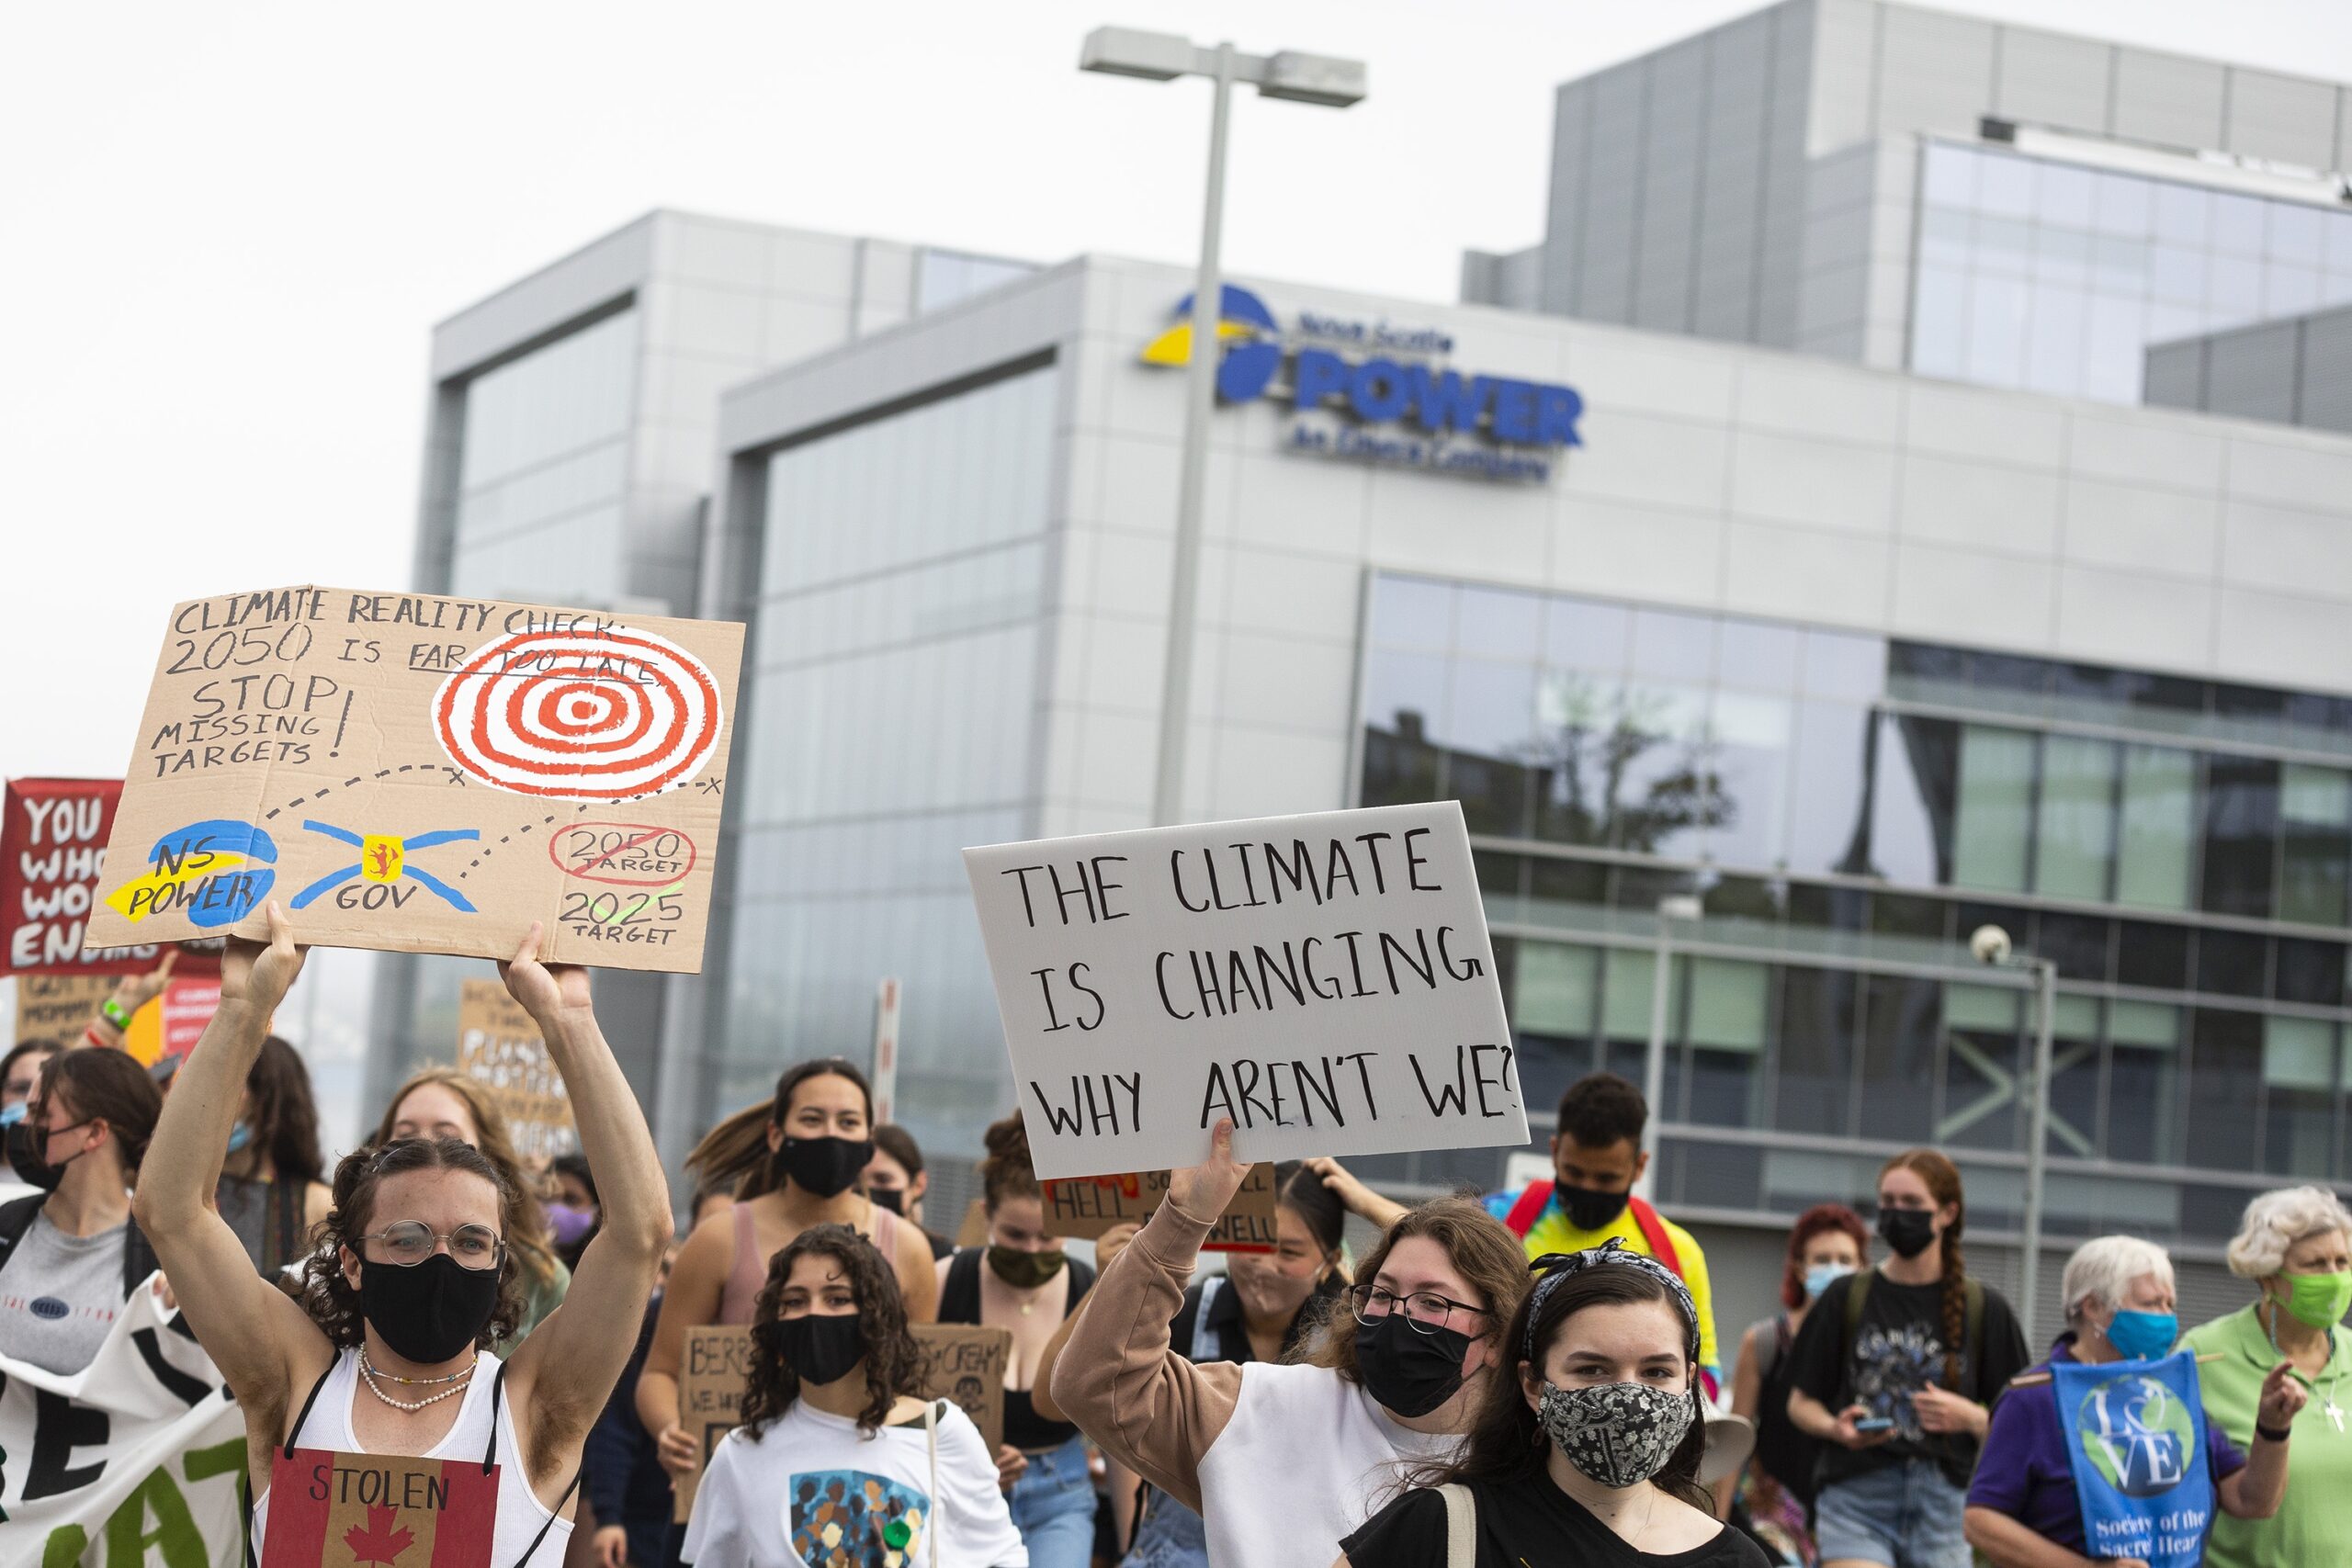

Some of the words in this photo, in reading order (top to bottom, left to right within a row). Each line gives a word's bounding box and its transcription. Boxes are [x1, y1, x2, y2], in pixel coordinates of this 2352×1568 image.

[1295, 346, 1584, 448] POWER
[175, 588, 329, 634] CLIMATE
[347, 593, 496, 632] REALITY
[504, 608, 627, 642] CHECK:
[166, 622, 313, 675] 2050
[337, 638, 381, 663] IS
[409, 643, 467, 669] FAR
[496, 649, 558, 673] TOO
[193, 673, 338, 718] STOP
[151, 714, 321, 750] MISSING
[23, 796, 102, 846] YOU
[154, 835, 217, 878] NS
[570, 830, 680, 859] 2050
[582, 857, 683, 873] TARGET
[129, 874, 254, 917] POWER
[335, 885, 418, 910] GOV
[1001, 855, 1130, 928] THE
[1170, 828, 1442, 913] CLIMATE
[21, 882, 96, 921] WO
[559, 892, 684, 926] 2025
[572, 924, 677, 945] TARGET
[1030, 962, 1105, 1032] IS
[1155, 926, 1485, 1021] CHANGING
[1030, 1072, 1141, 1136] WHY
[1200, 1052, 1379, 1130] AREN'T
[1408, 1043, 1519, 1118] WE?
[1051, 1181, 1135, 1220] HELL
[309, 1464, 450, 1511] STOLEN
[2160, 1511, 2179, 1531] of
[2182, 1508, 2205, 1529] the
